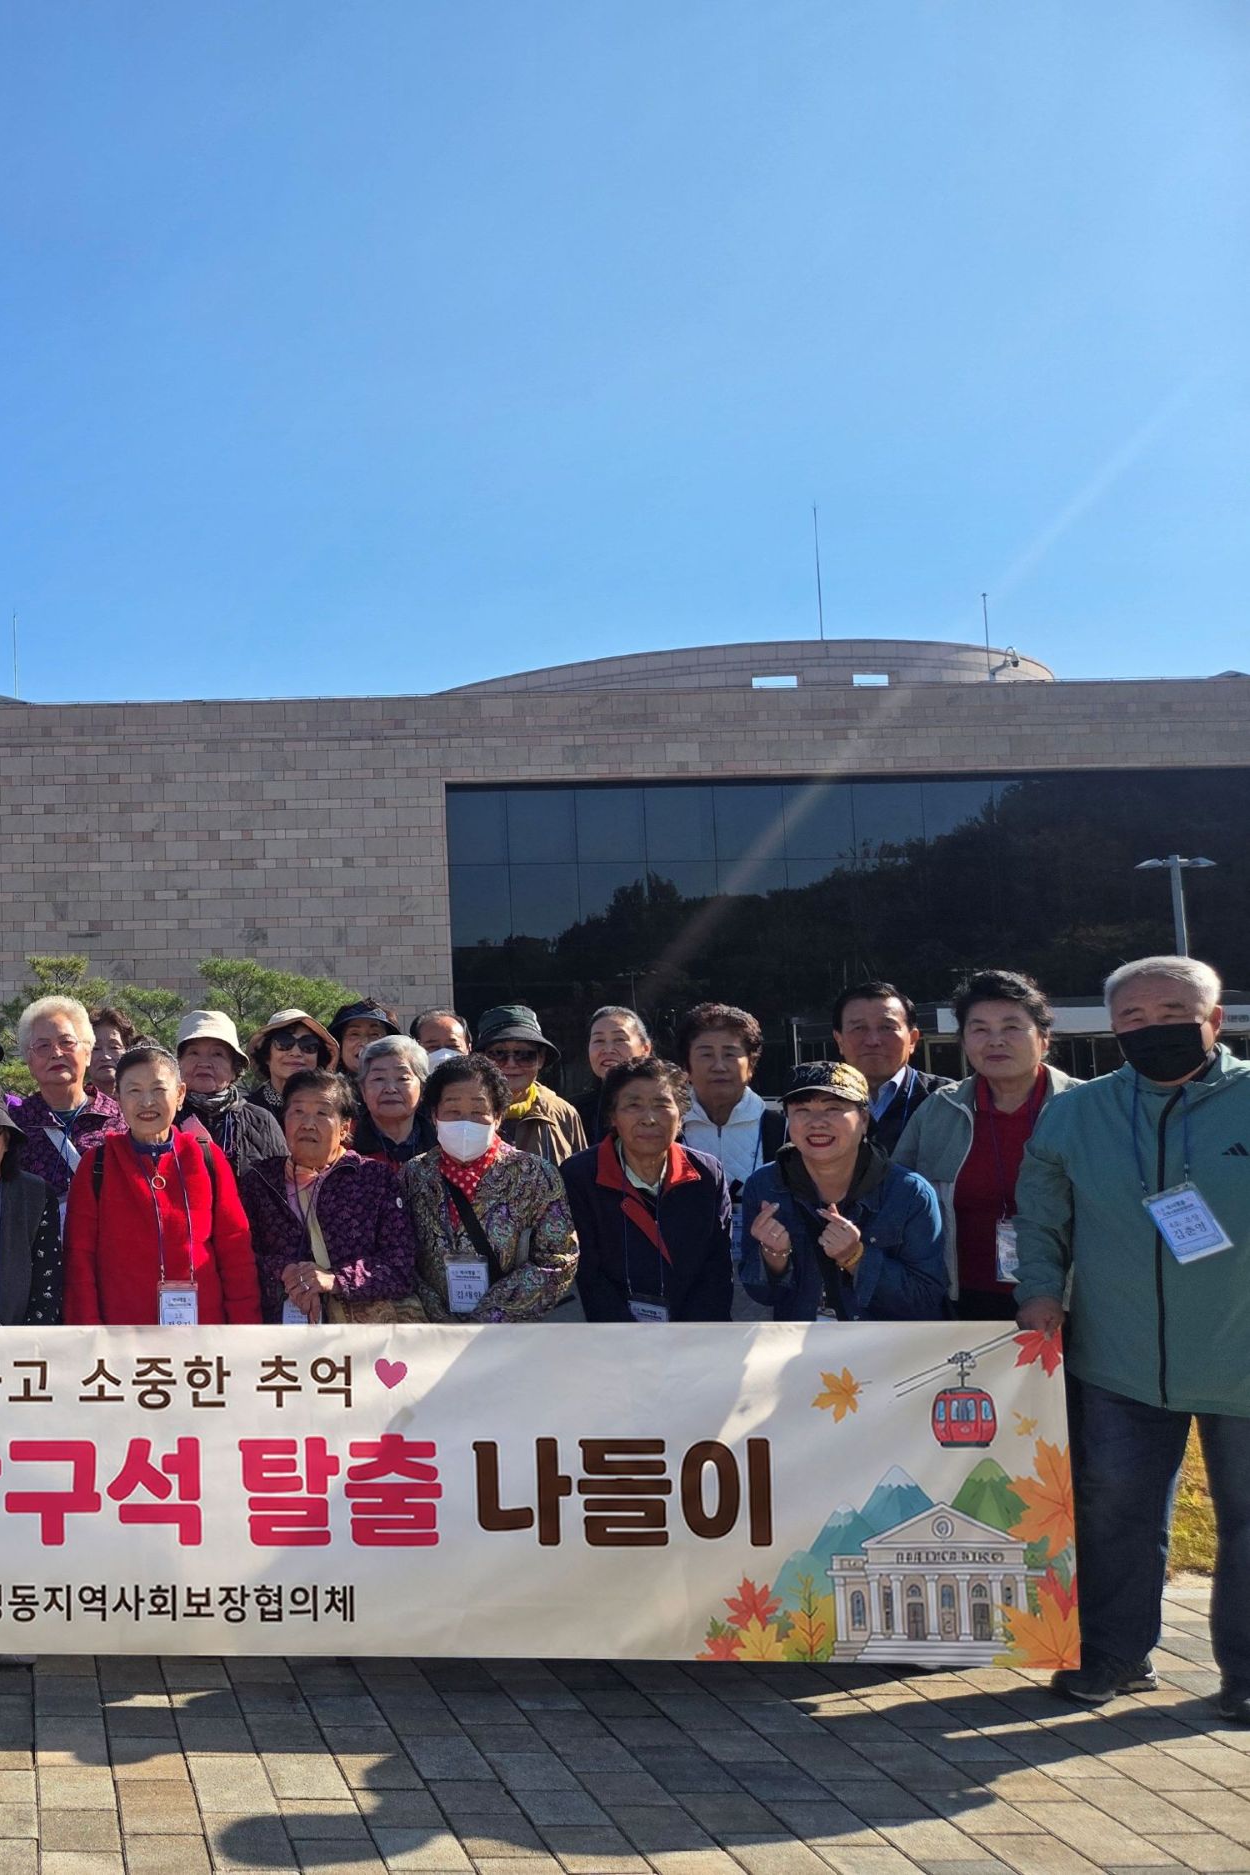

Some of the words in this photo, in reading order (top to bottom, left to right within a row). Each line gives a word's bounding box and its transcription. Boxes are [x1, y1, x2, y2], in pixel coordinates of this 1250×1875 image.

[78, 1354, 231, 1410] 소중한
[256, 1355, 352, 1408] 추억
[238, 1434, 442, 1547] 탈출
[472, 1438, 773, 1547] 나들이
